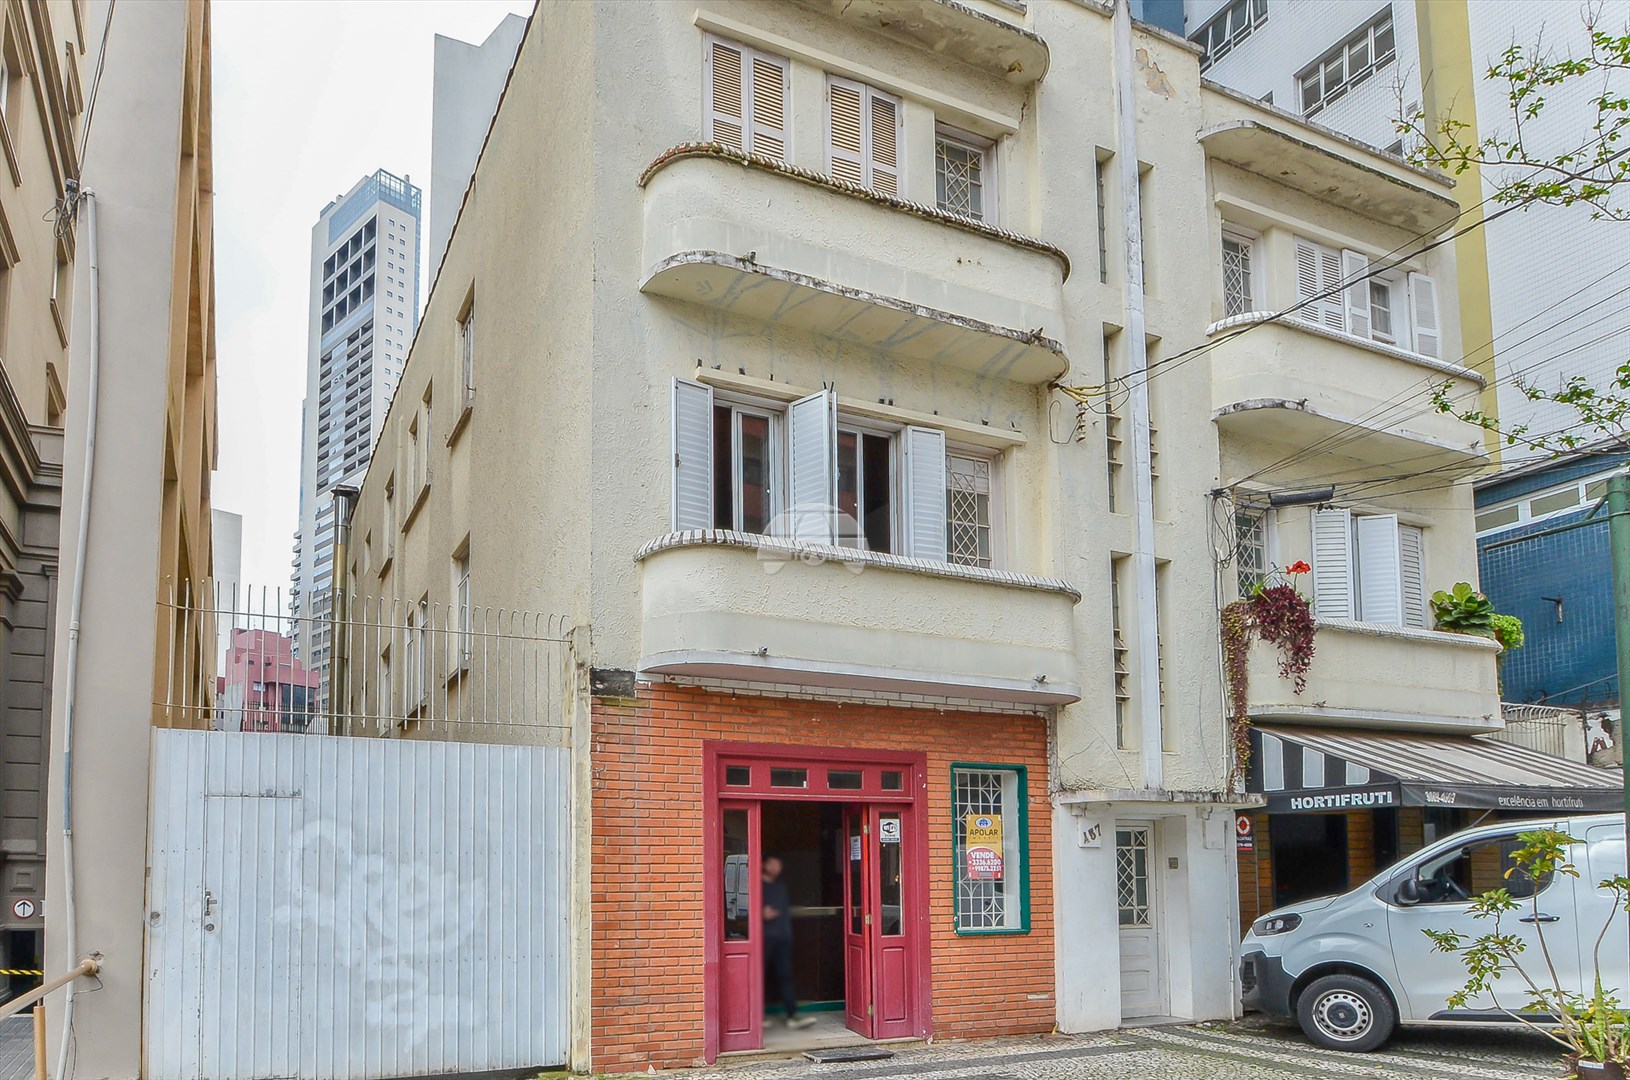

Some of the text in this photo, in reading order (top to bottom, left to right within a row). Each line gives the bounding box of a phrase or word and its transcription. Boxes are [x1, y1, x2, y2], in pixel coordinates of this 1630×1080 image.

[1291, 791, 1393, 809] HORTIFRUTI
[1537, 799, 1549, 808] em
[1551, 796, 1584, 808] hortifruti
[969, 828, 998, 836] APOLAR
[970, 851, 995, 859] VENDE
